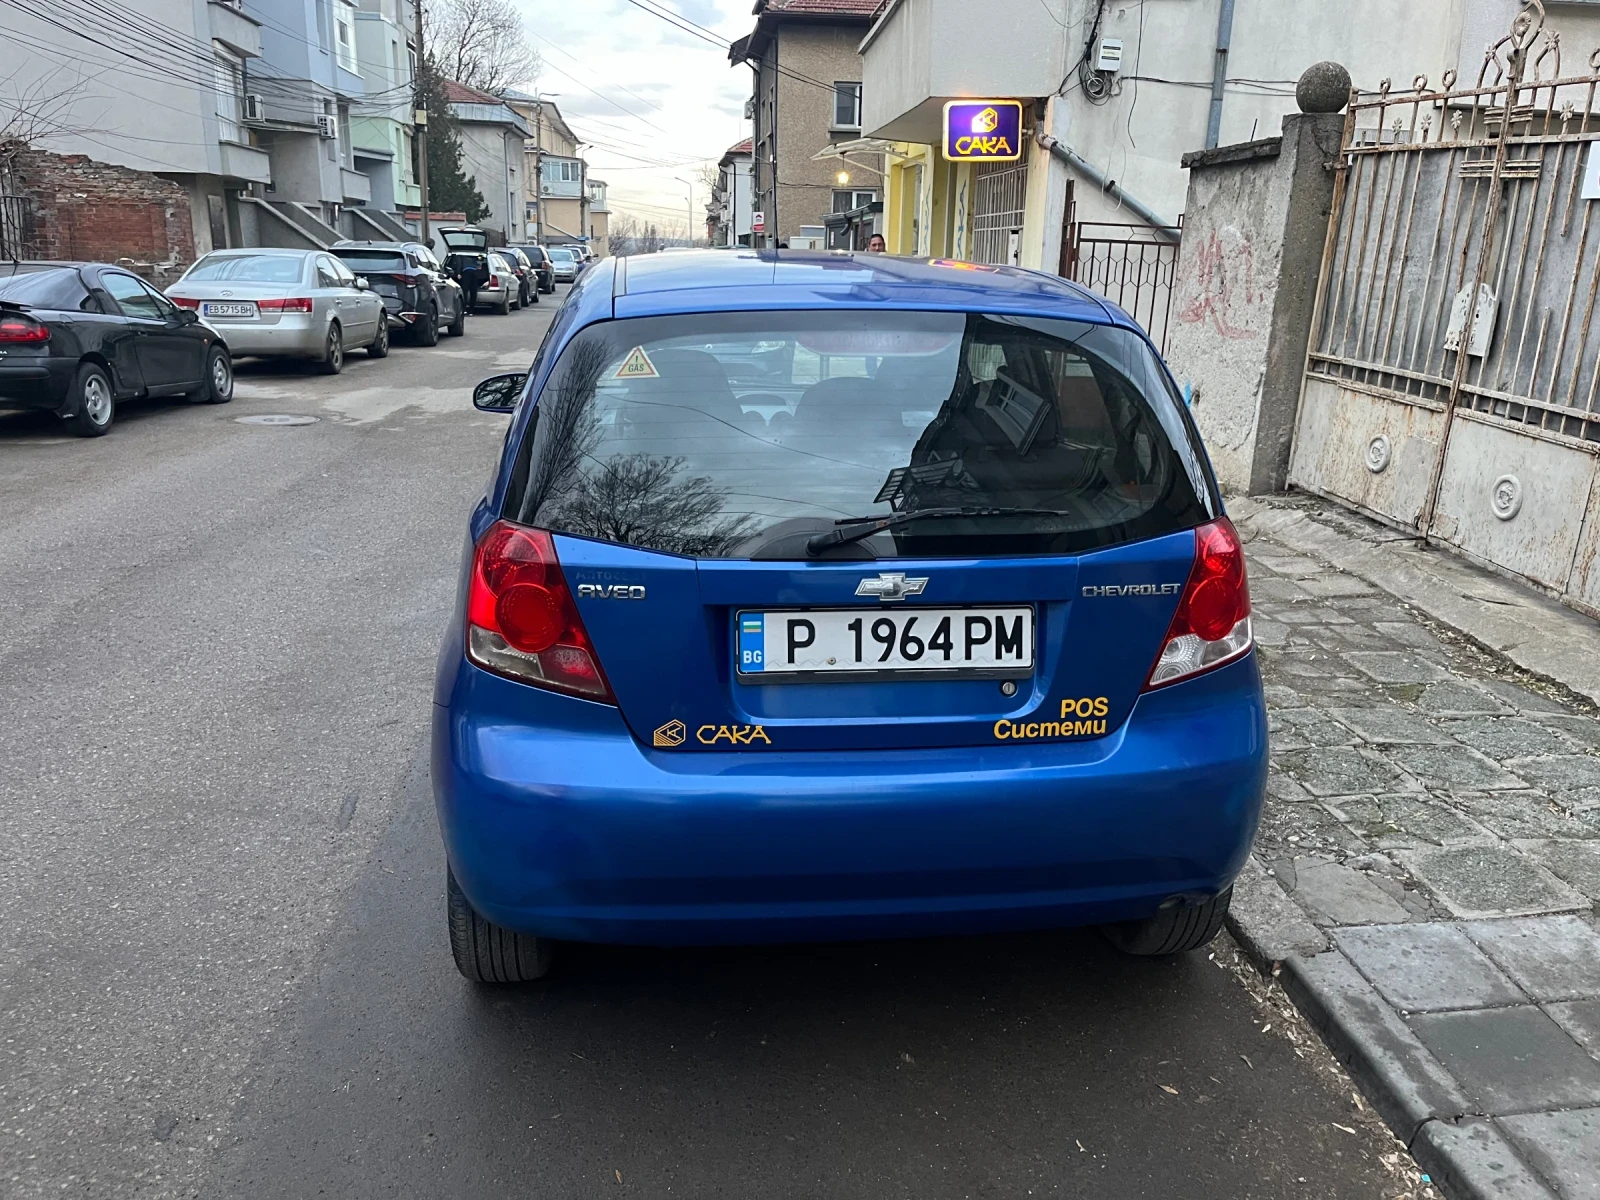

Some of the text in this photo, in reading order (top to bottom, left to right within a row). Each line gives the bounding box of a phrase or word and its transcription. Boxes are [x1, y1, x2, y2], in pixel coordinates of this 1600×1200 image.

[955, 136, 1012, 155] САКА
[209, 305, 252, 314] EB 5715 BH
[628, 364, 644, 372] GAS
[578, 584, 646, 599] AVEO
[1082, 583, 1180, 597] CHEVROLET
[743, 615, 1024, 664] BG P 1964 PM
[1060, 696, 1109, 719] POS
[696, 725, 772, 744] САКА
[993, 719, 1107, 739] Системи
